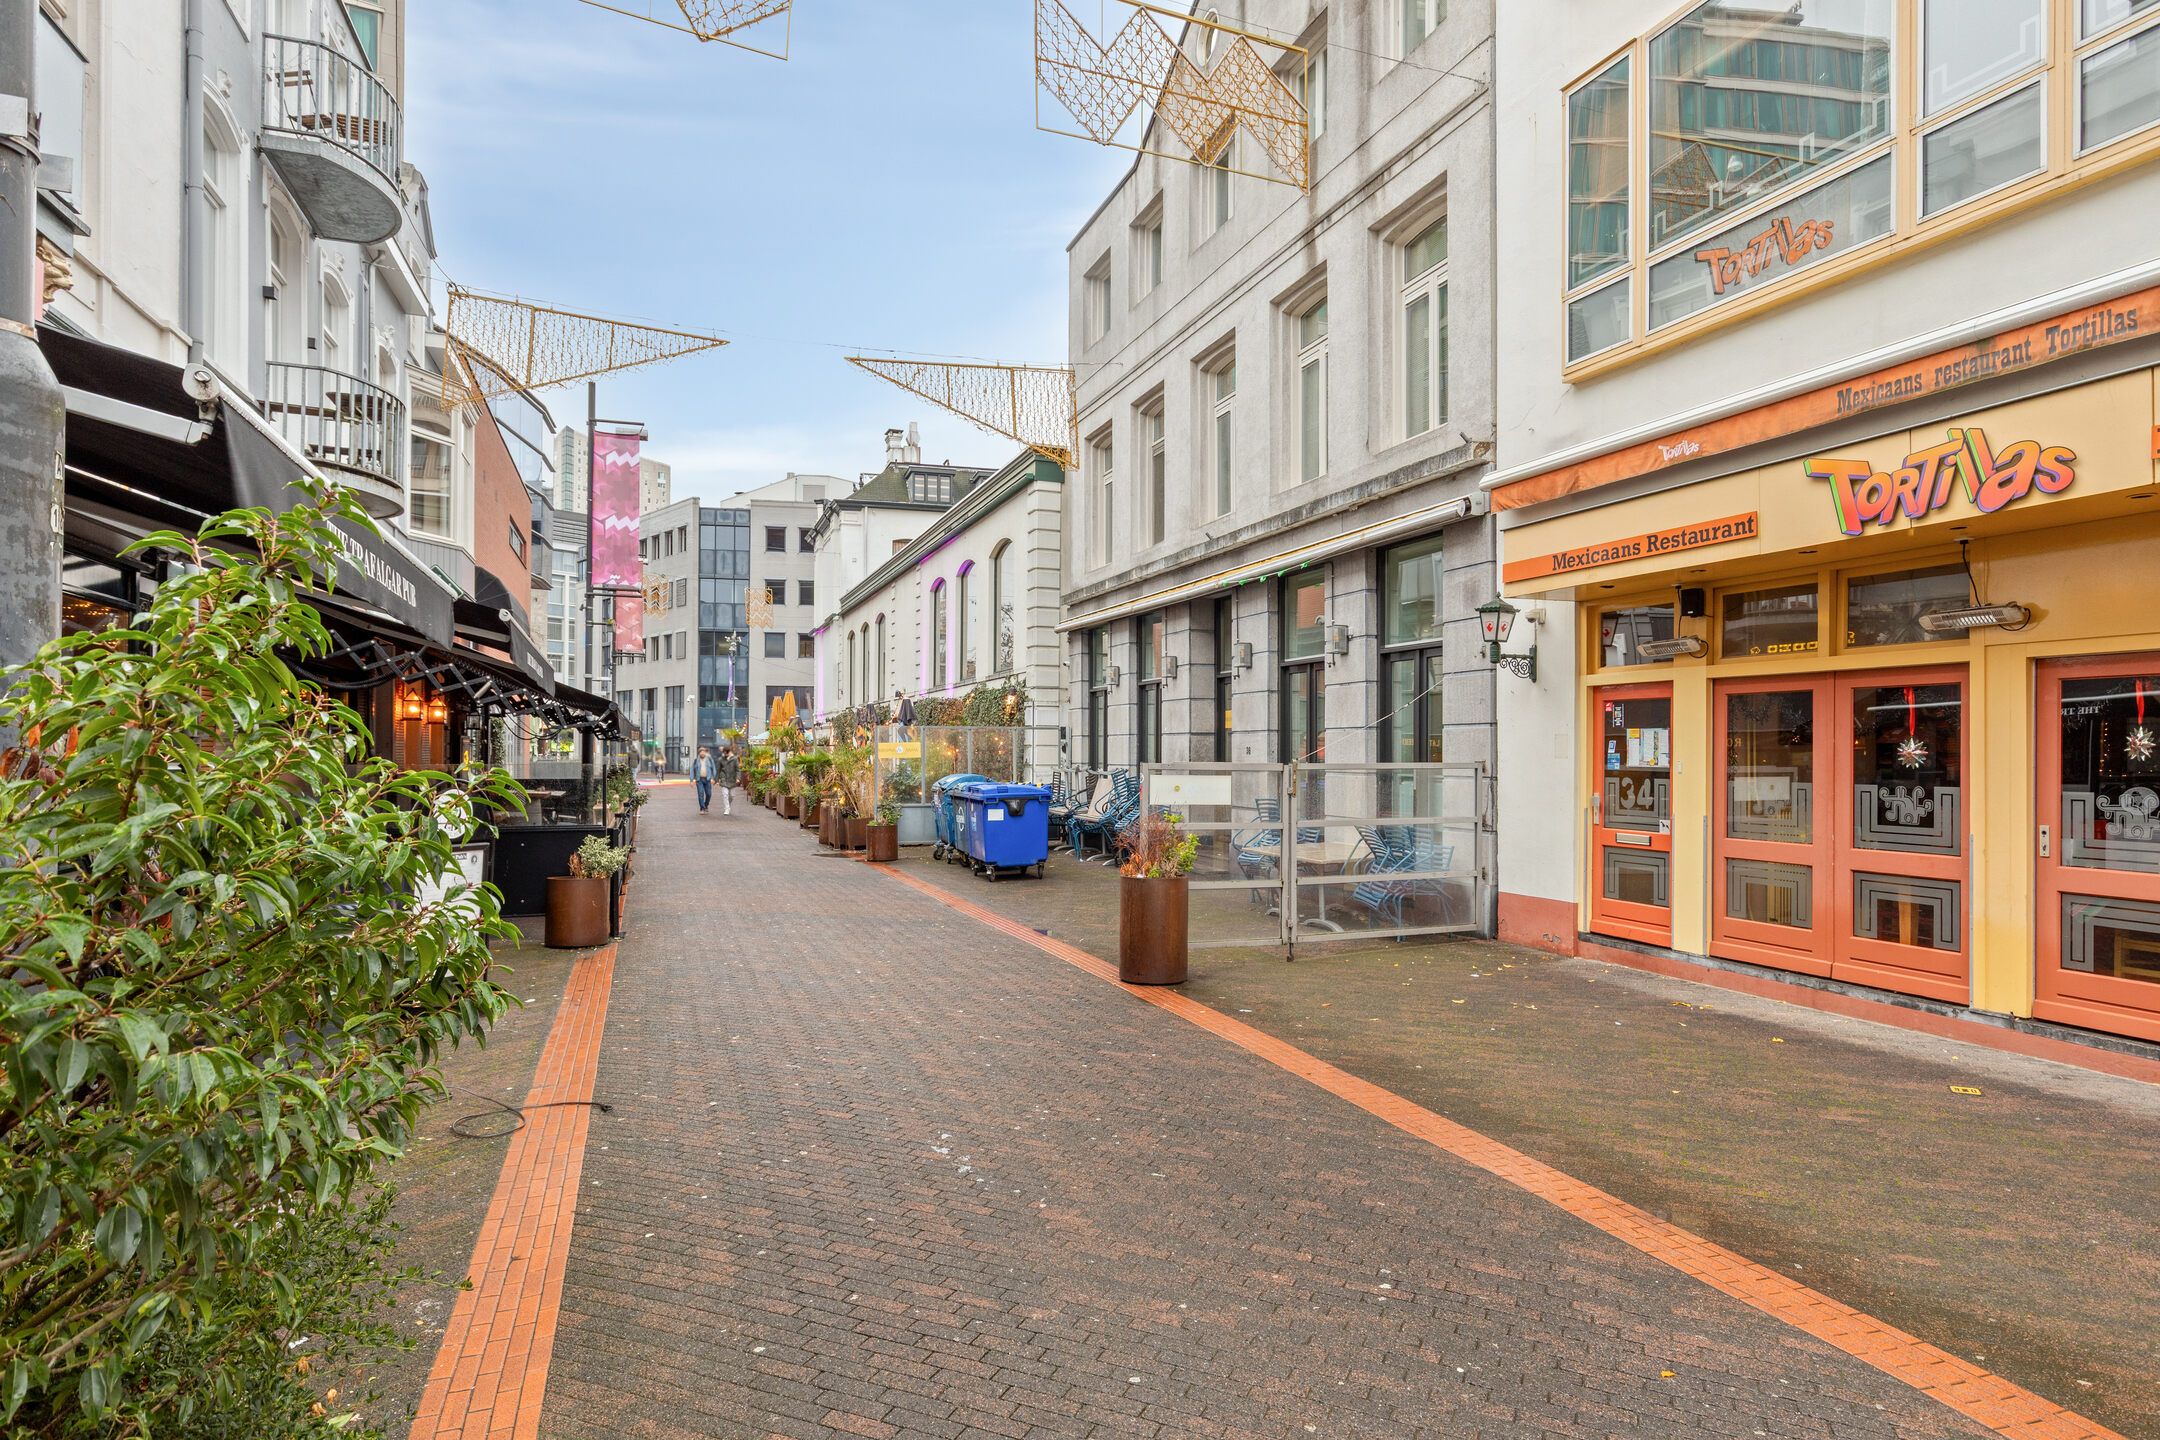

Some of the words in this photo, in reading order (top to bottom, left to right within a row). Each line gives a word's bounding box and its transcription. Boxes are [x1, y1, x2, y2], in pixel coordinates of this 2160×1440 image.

[1836, 371, 1923, 415] Mexicaans
[1934, 335, 2032, 388] restaurant
[2045, 307, 2139, 355] Tortillas
[1552, 541, 1641, 571] Mexicaans
[1646, 515, 1755, 553] Restaurant
[402, 577, 417, 608] PUB
[1621, 777, 1654, 809] 34
